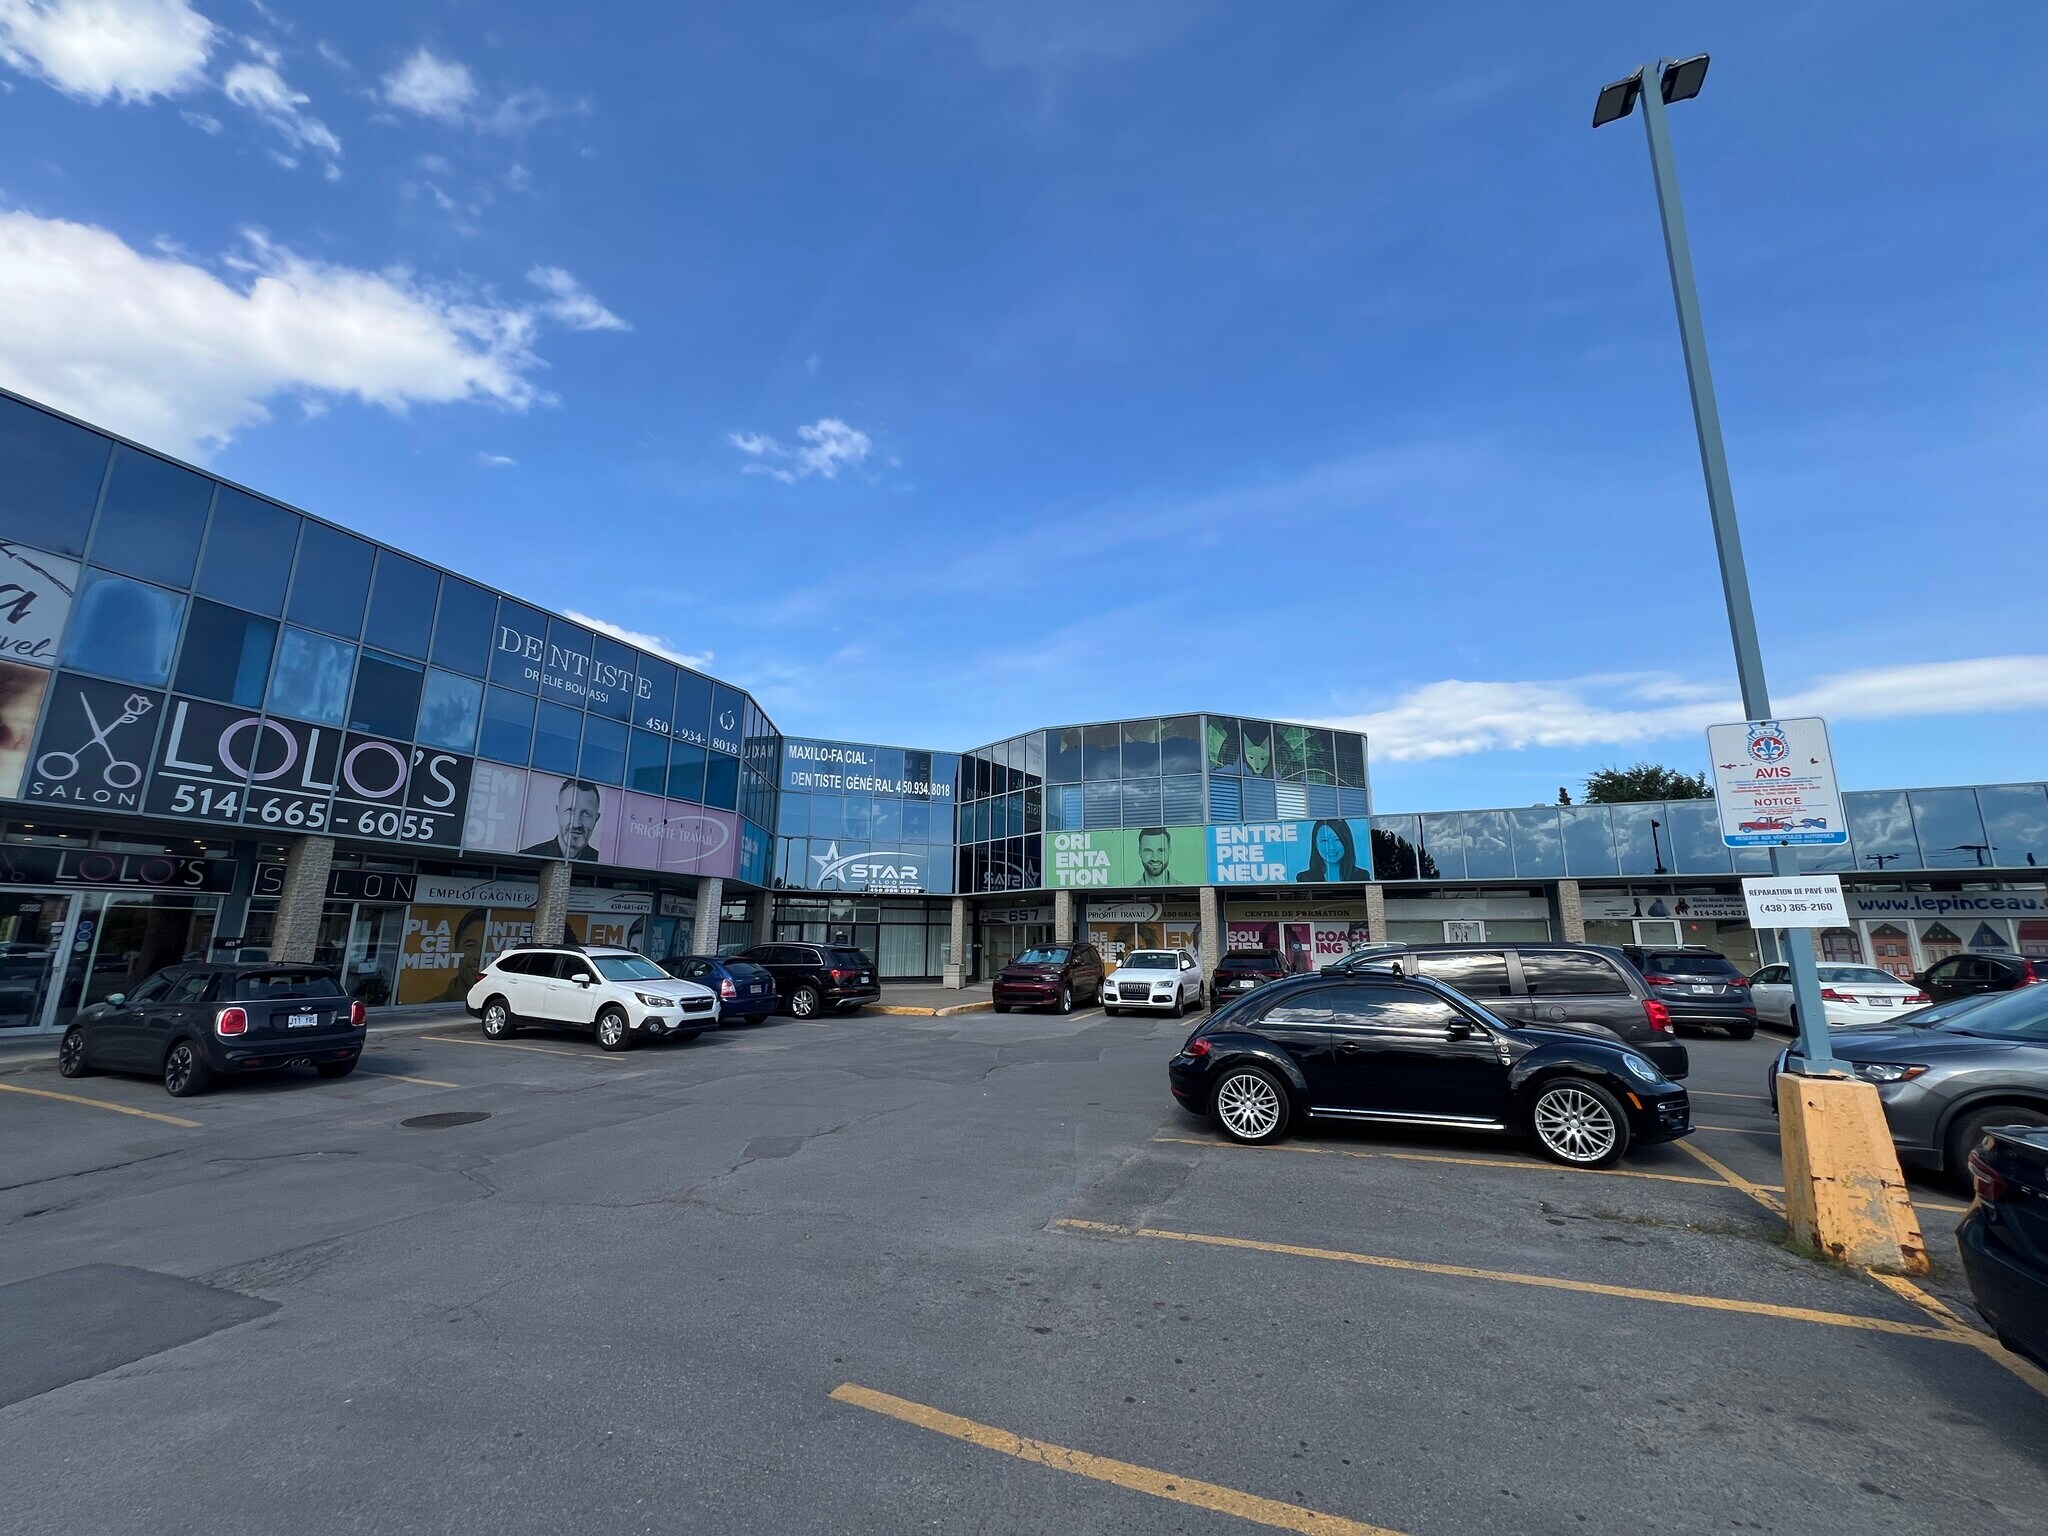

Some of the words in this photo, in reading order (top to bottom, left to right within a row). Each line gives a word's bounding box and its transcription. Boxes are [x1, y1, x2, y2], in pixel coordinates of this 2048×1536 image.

[498, 625, 653, 700] DENTISTE
[524, 667, 539, 682] DR
[543, 673, 563, 691] ELIE
[164, 701, 457, 808] LOLO'S
[473, 766, 518, 796] EM
[1755, 766, 1792, 779] AVIS
[791, 771, 841, 789] DENTISTE
[846, 773, 894, 793] GÉNÉRAL
[31, 781, 136, 806] SALON
[1754, 797, 1802, 806] NOTICE
[469, 792, 506, 820] PL
[465, 818, 497, 845] OI
[679, 829, 714, 847] TRAVAIL
[1215, 824, 1297, 844] ENTRE
[1054, 834, 1090, 851] ORI
[1055, 851, 1111, 868] ENTA
[1216, 844, 1264, 863] PRE
[56, 851, 205, 886] LOLO'S
[851, 864, 918, 880] STAR
[1056, 868, 1108, 886] TION
[1217, 863, 1286, 882] NEUR
[429, 887, 475, 901] EMPLOI
[479, 890, 531, 903] GAGNIER
[1748, 887, 1793, 897] RÉPARATION
[1794, 887, 1803, 895] DE
[1804, 886, 1822, 894] PAVÉ
[1824, 886, 1838, 894] UNI
[1009, 909, 1040, 922] 657
[1120, 910, 1146, 918] TRAVAIL
[1245, 910, 1280, 918] CENTRE
[1295, 909, 1350, 917] FORMATION
[1759, 903, 1787, 914] (438)
[1788, 902, 1833, 912] 365-2160
[407, 919, 450, 936] PLA
[590, 923, 625, 944] EM
[420, 936, 450, 953] CE
[1090, 931, 1108, 942] RE
[1228, 930, 1260, 943] SOU
[1315, 930, 1370, 943] COACH
[1316, 942, 1344, 954] ING
[401, 953, 465, 970] MENT
